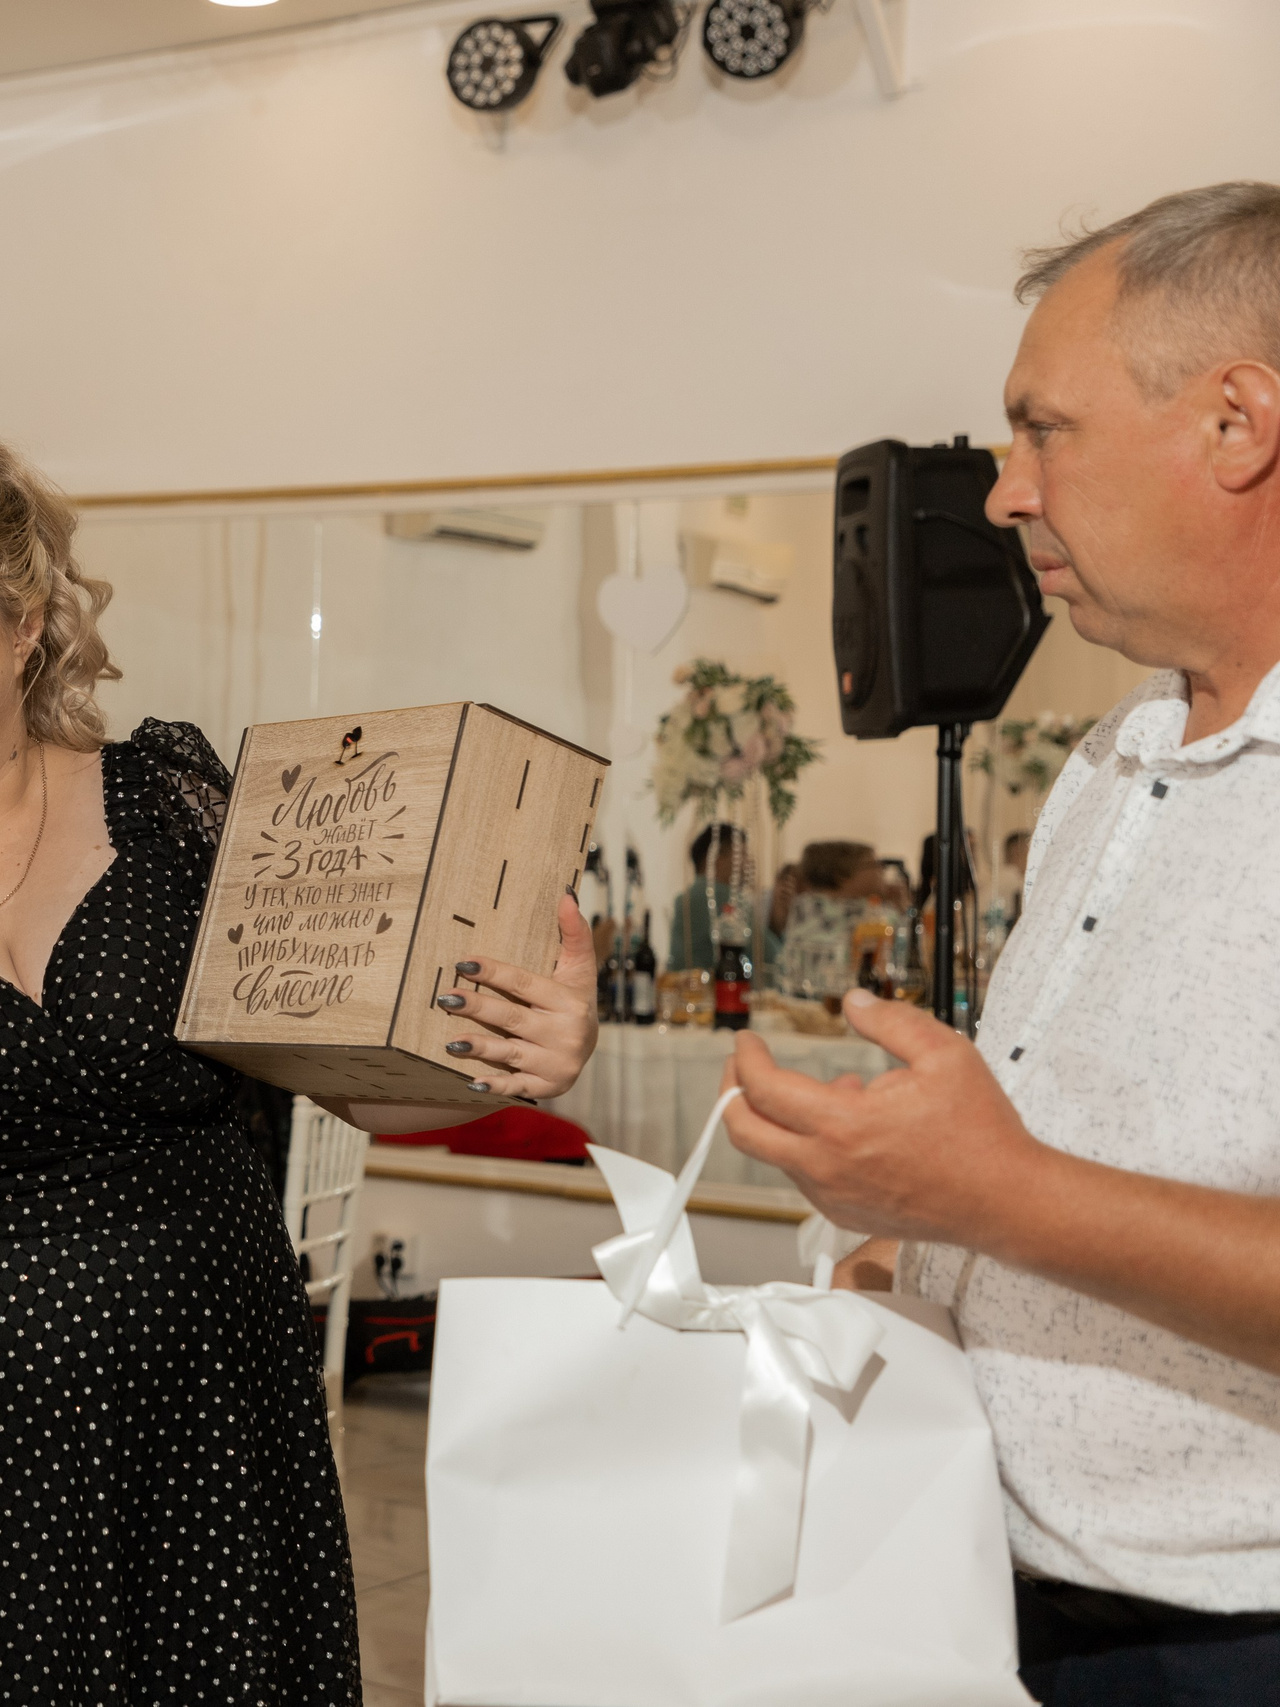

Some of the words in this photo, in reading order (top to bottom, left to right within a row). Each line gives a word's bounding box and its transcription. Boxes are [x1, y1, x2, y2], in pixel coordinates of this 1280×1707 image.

[272, 752, 400, 831] Любовь
[275, 840, 302, 880] 3
[306, 845, 368, 879] ГОДА
[244, 884, 258, 910] У
[262, 886, 289, 909] ТЕХ,
[294, 885, 322, 906] КТО
[326, 884, 346, 904] НЕ
[348, 882, 395, 903] ЗНАЕТ
[253, 911, 294, 936] что
[299, 907, 375, 932] можно
[238, 937, 376, 972] ПРИБУХИВАТЬ
